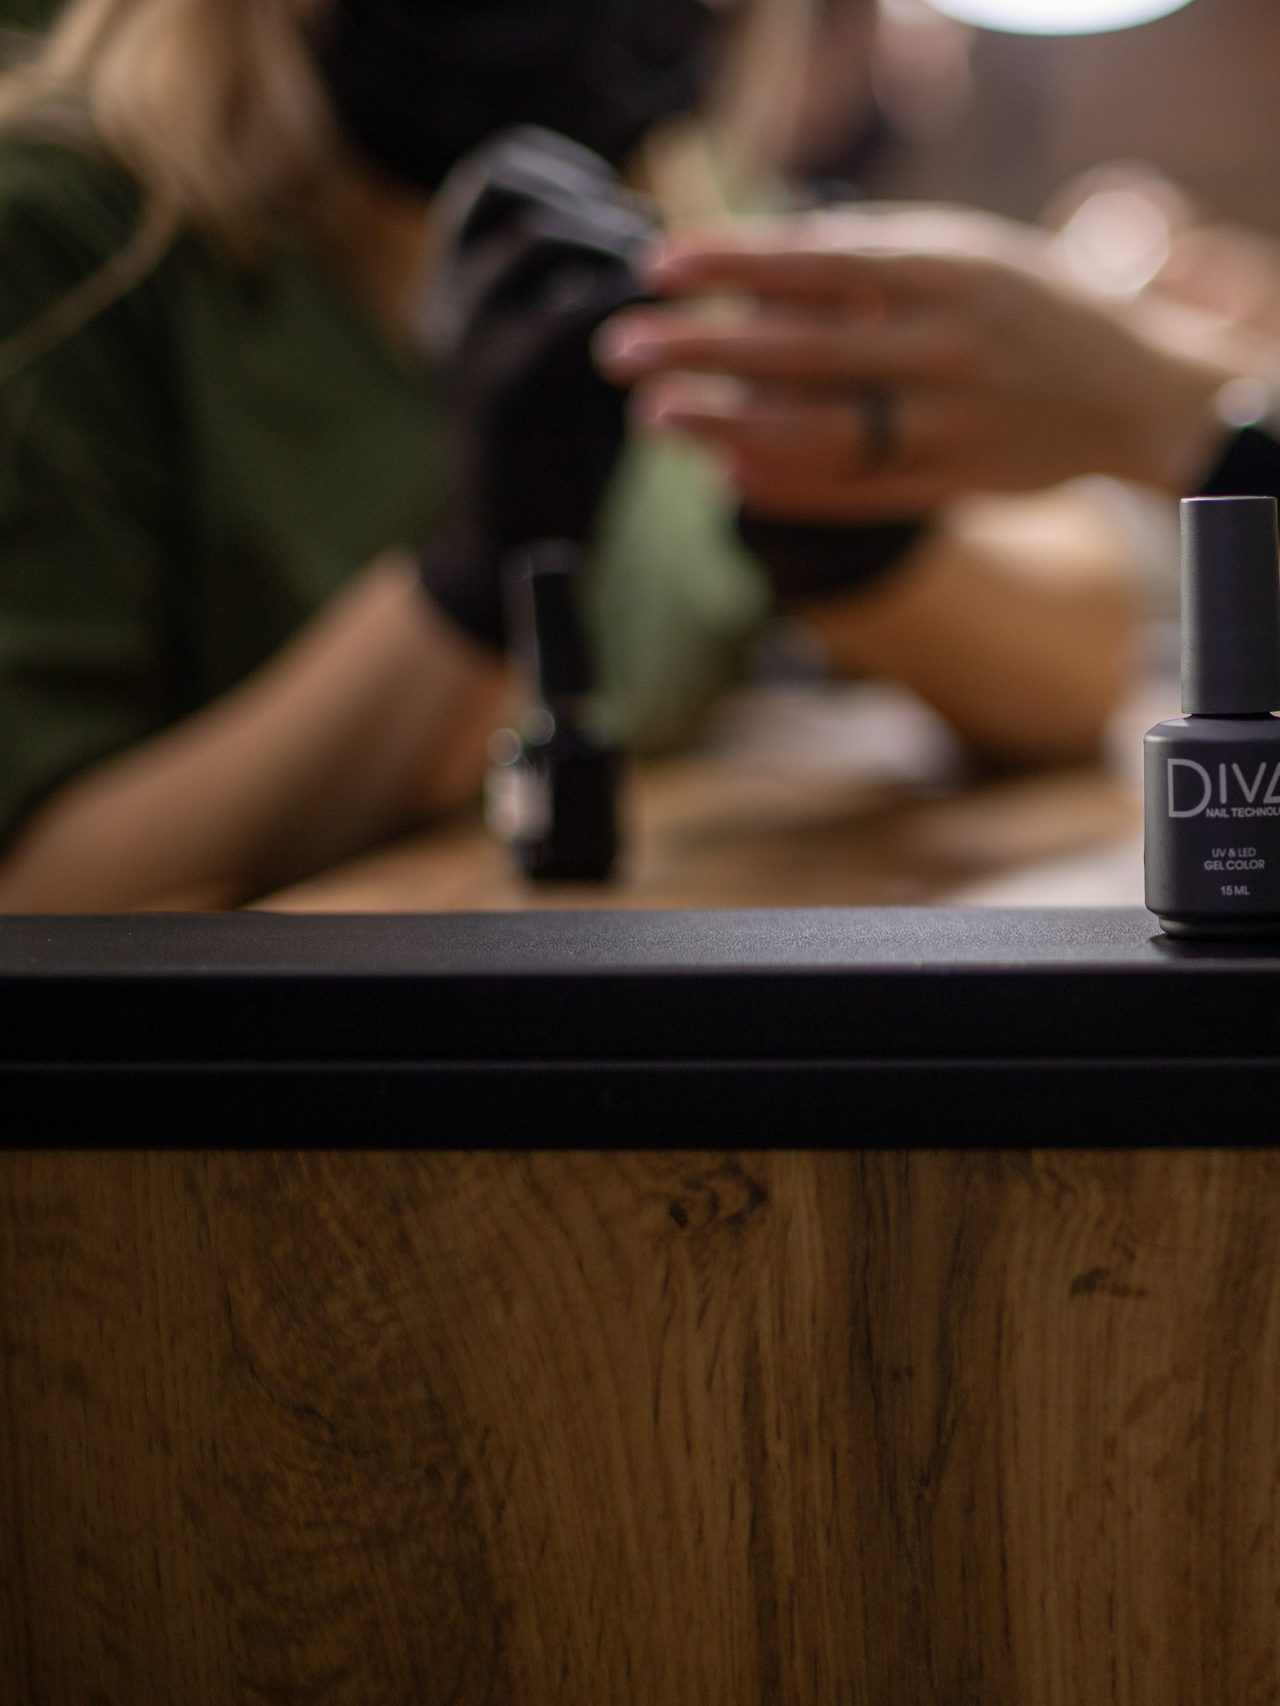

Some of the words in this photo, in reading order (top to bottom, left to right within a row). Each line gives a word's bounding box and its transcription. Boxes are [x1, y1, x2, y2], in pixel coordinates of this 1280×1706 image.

[1206, 807, 1229, 818] NAIL
[1212, 848, 1226, 858] UV
[1228, 848, 1236, 858] &
[1238, 847, 1256, 857] LED
[1204, 860, 1225, 870] GEL
[1226, 860, 1265, 870] COLOR
[1221, 885, 1233, 895] 15
[1235, 885, 1250, 895] ML
